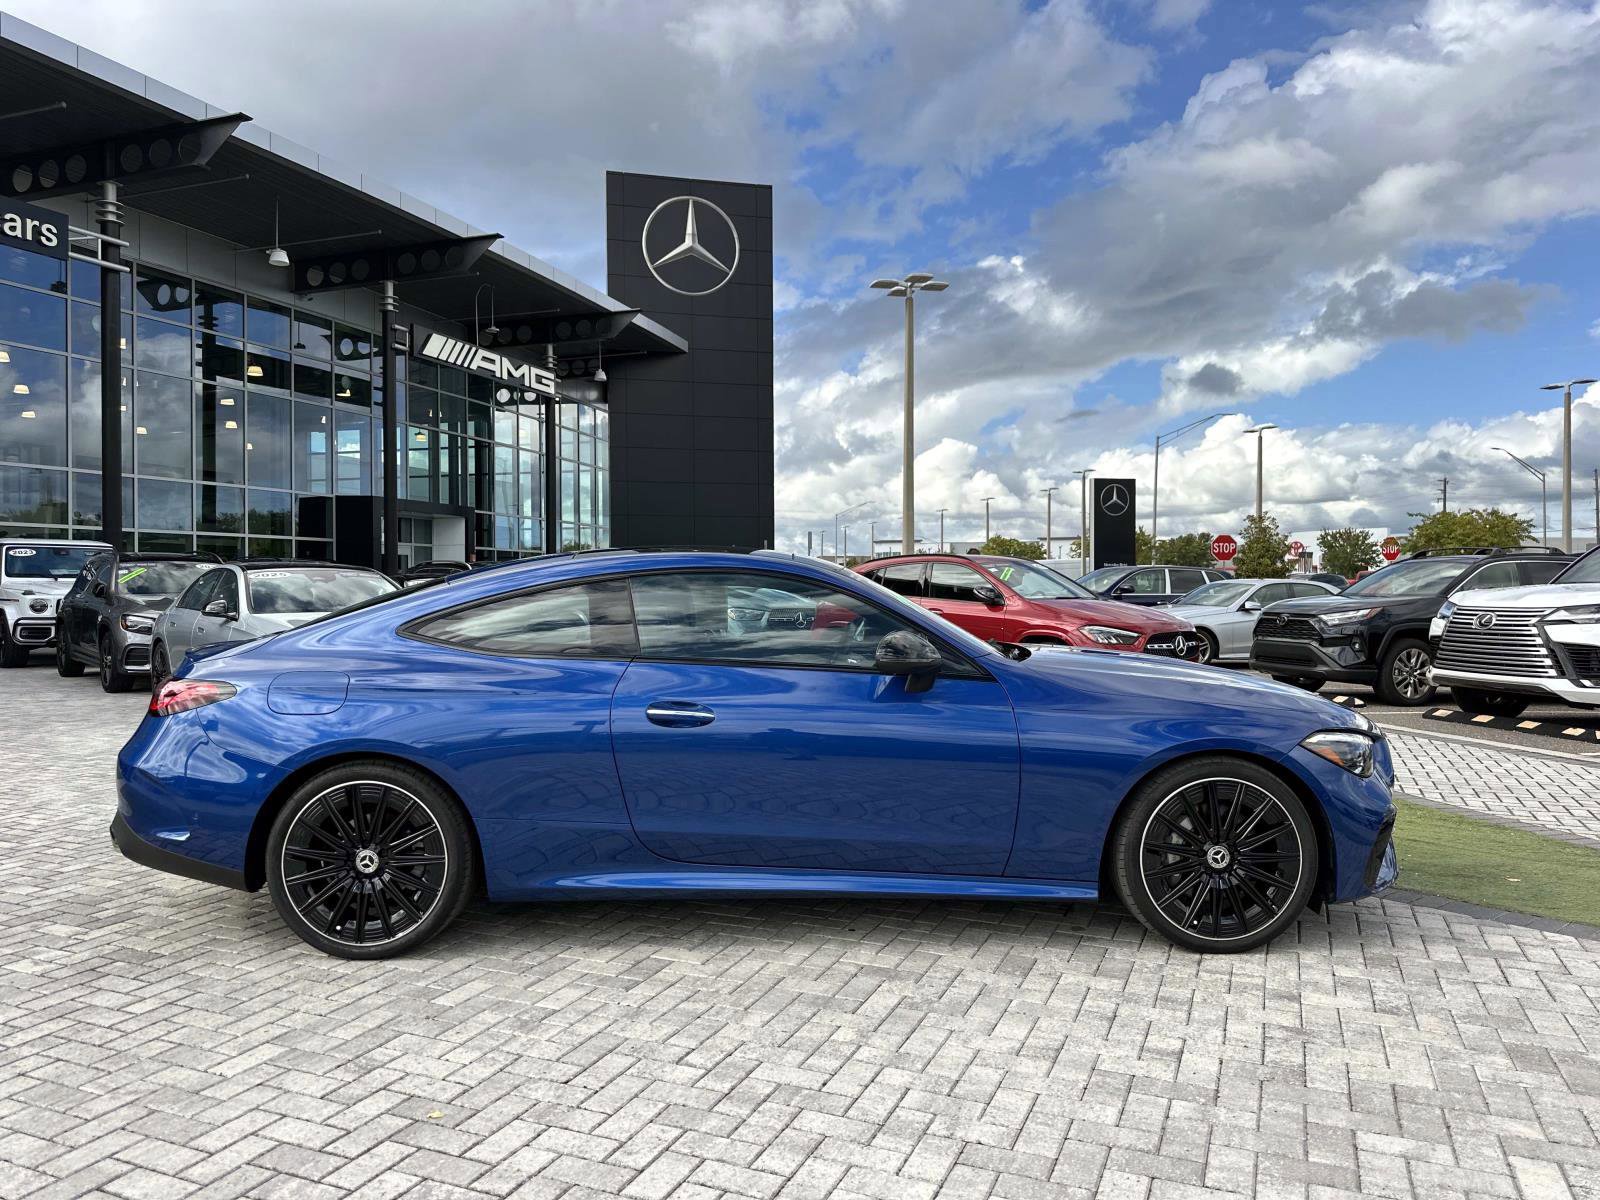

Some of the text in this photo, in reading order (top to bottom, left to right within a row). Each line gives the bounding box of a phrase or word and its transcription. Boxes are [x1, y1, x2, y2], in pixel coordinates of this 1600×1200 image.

[0, 213, 58, 247] ars
[470, 348, 555, 395] AMG
[1213, 542, 1236, 553] STOP
